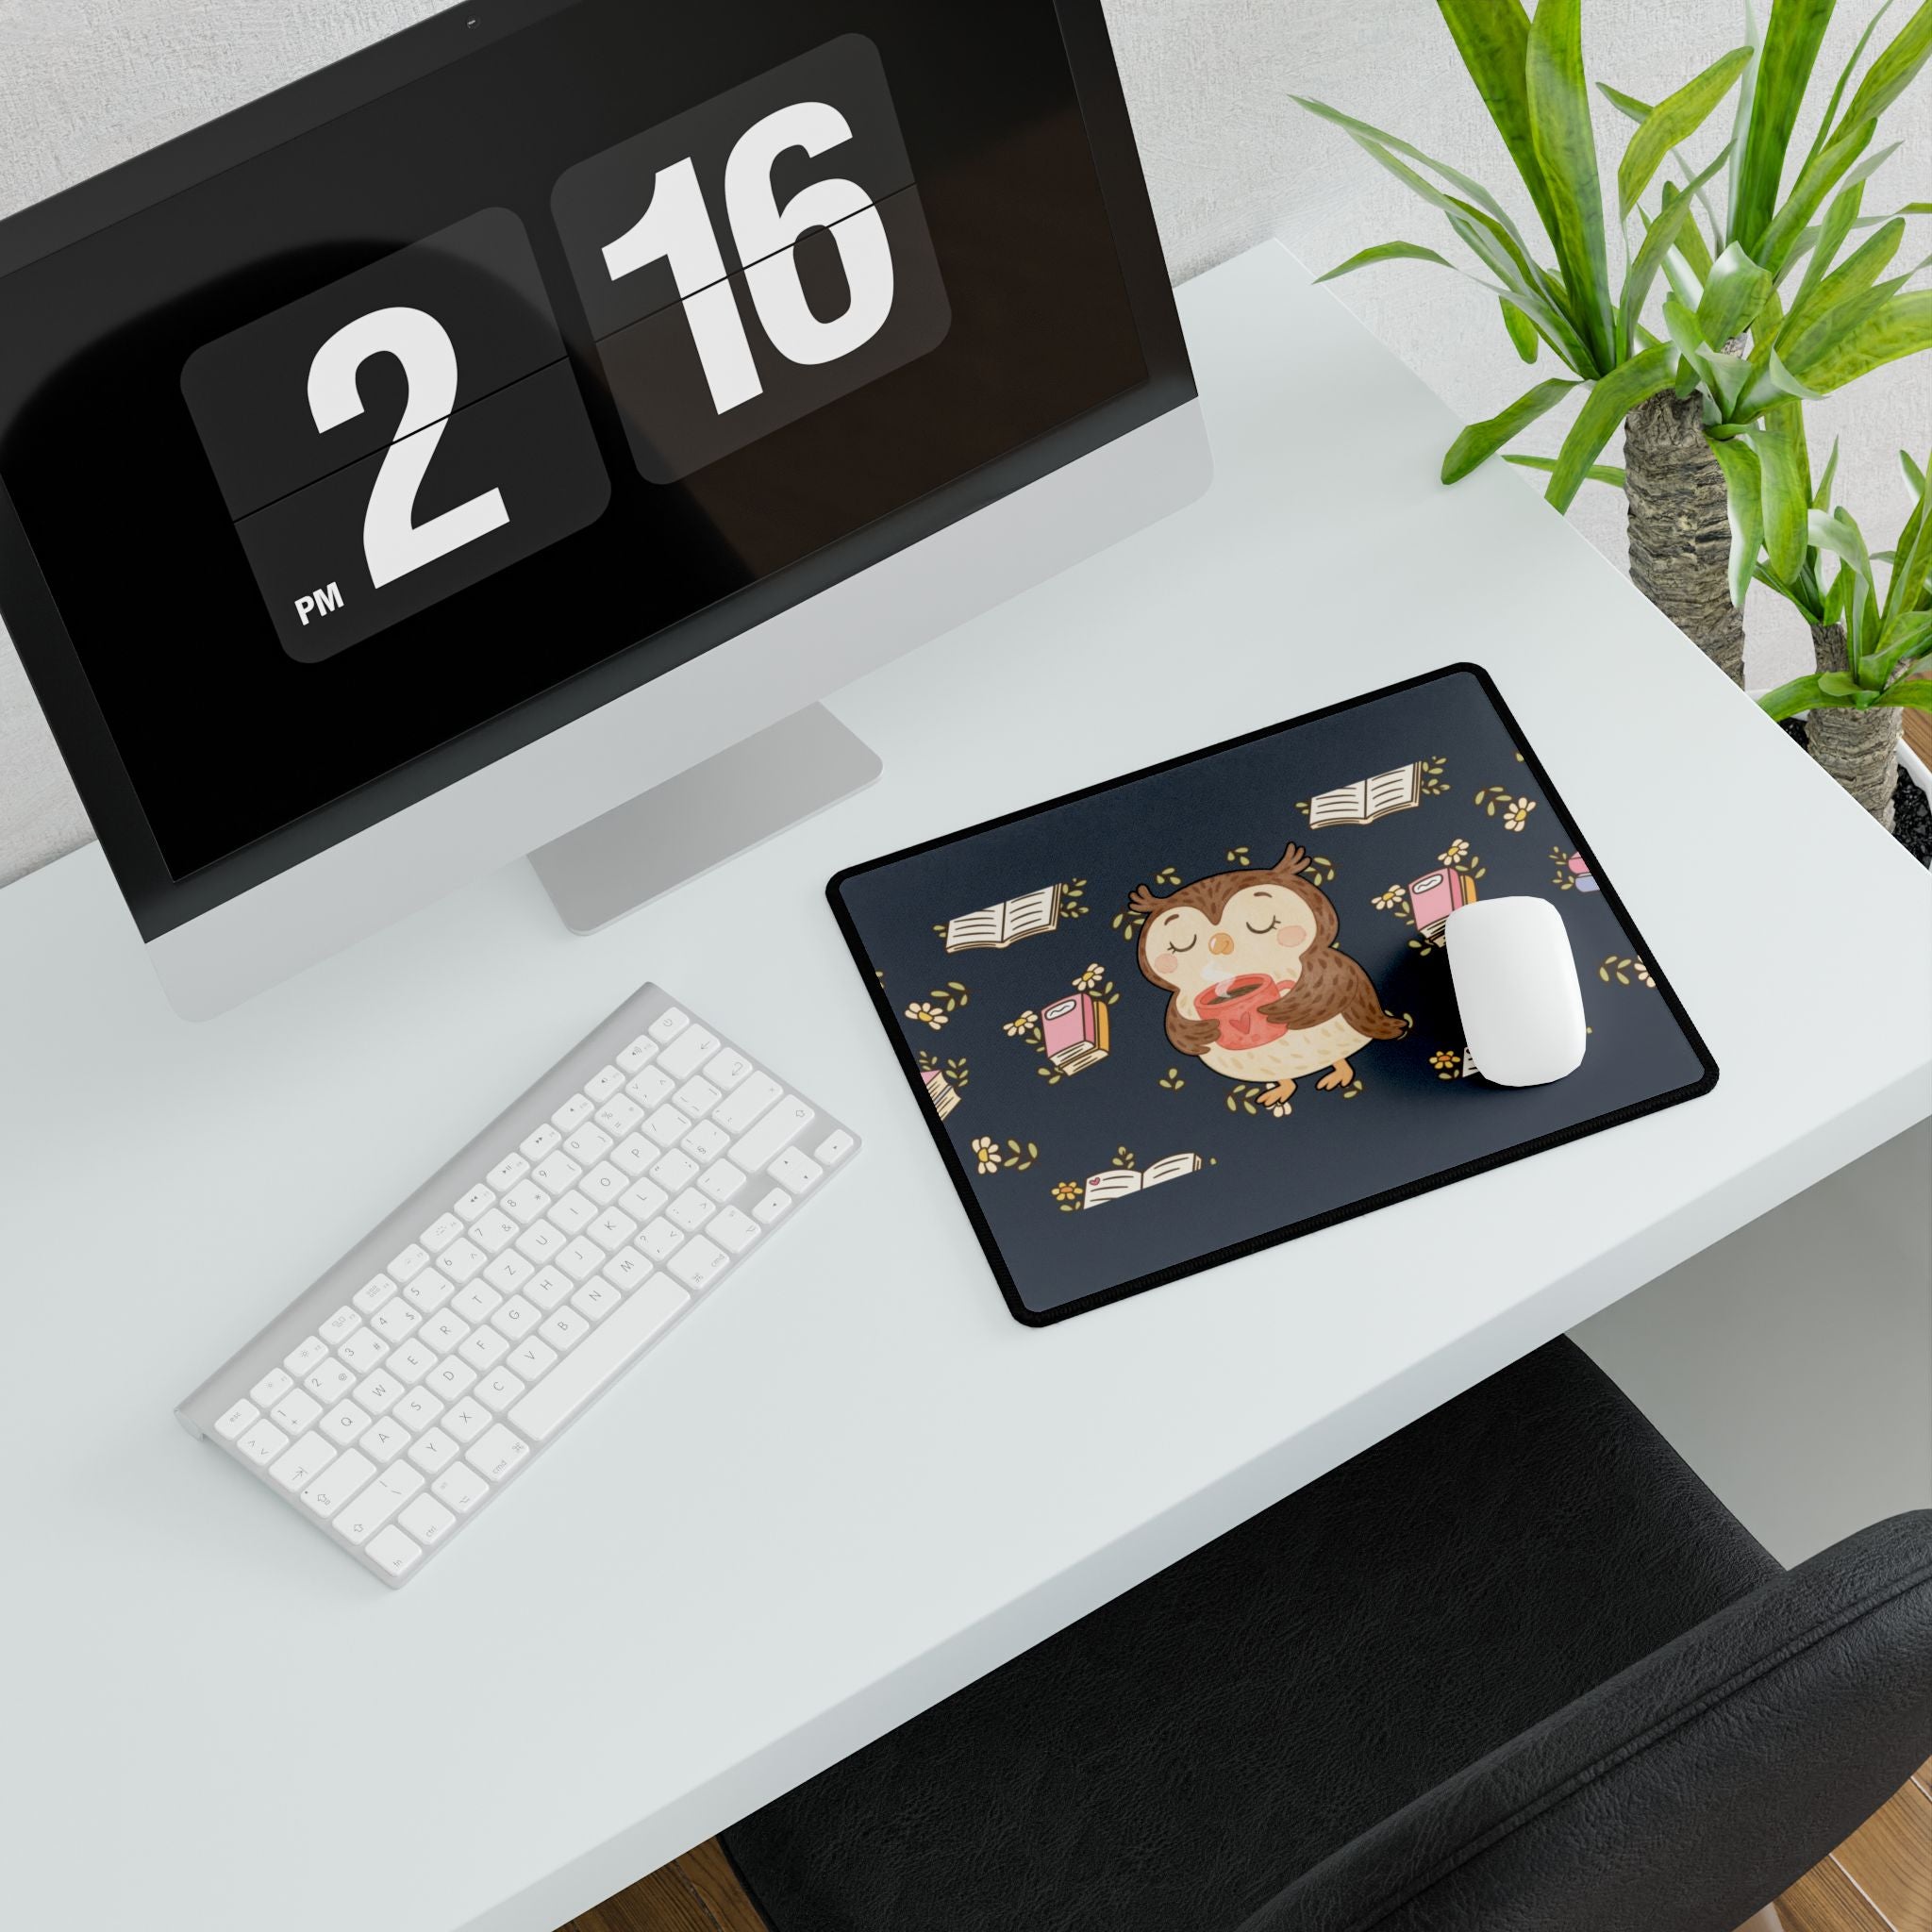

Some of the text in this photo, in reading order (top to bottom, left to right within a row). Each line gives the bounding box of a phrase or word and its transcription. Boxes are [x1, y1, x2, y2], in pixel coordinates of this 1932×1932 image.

[602, 102, 893, 414] 16
[308, 307, 509, 589] 2
[294, 582, 343, 625] PM
[311, 1377, 323, 1388] 2
[344, 1347, 355, 1357] 3
[379, 1317, 388, 1325] 4
[410, 1287, 420, 1297] 5
[443, 1257, 453, 1266] 6
[475, 1227, 483, 1237] 7
[507, 1199, 517, 1208] 8
[539, 1170, 547, 1178] 9
[570, 1141, 580, 1149] 0
[341, 1417, 354, 1427] Q
[372, 1384, 386, 1397] W
[407, 1355, 419, 1366] E
[439, 1325, 451, 1335] R
[472, 1294, 483, 1304] T
[504, 1264, 516, 1276] Z
[535, 1235, 548, 1246] U
[600, 1177, 611, 1187] O
[630, 1148, 640, 1158] P
[378, 1433, 391, 1443] A
[410, 1401, 422, 1411] S
[442, 1371, 455, 1381] D
[475, 1340, 486, 1350] F
[508, 1309, 520, 1320] G
[540, 1279, 553, 1291] H
[574, 1251, 583, 1260] J
[604, 1222, 616, 1231] K
[425, 1442, 437, 1452] Y
[459, 1411, 473, 1424] X
[492, 1381, 505, 1391] C
[525, 1350, 535, 1359] V
[557, 1321, 569, 1331] B
[588, 1290, 602, 1302] N
[620, 1260, 635, 1273] M
[492, 1459, 508, 1474] cmd
[710, 1253, 725, 1268] cmd
